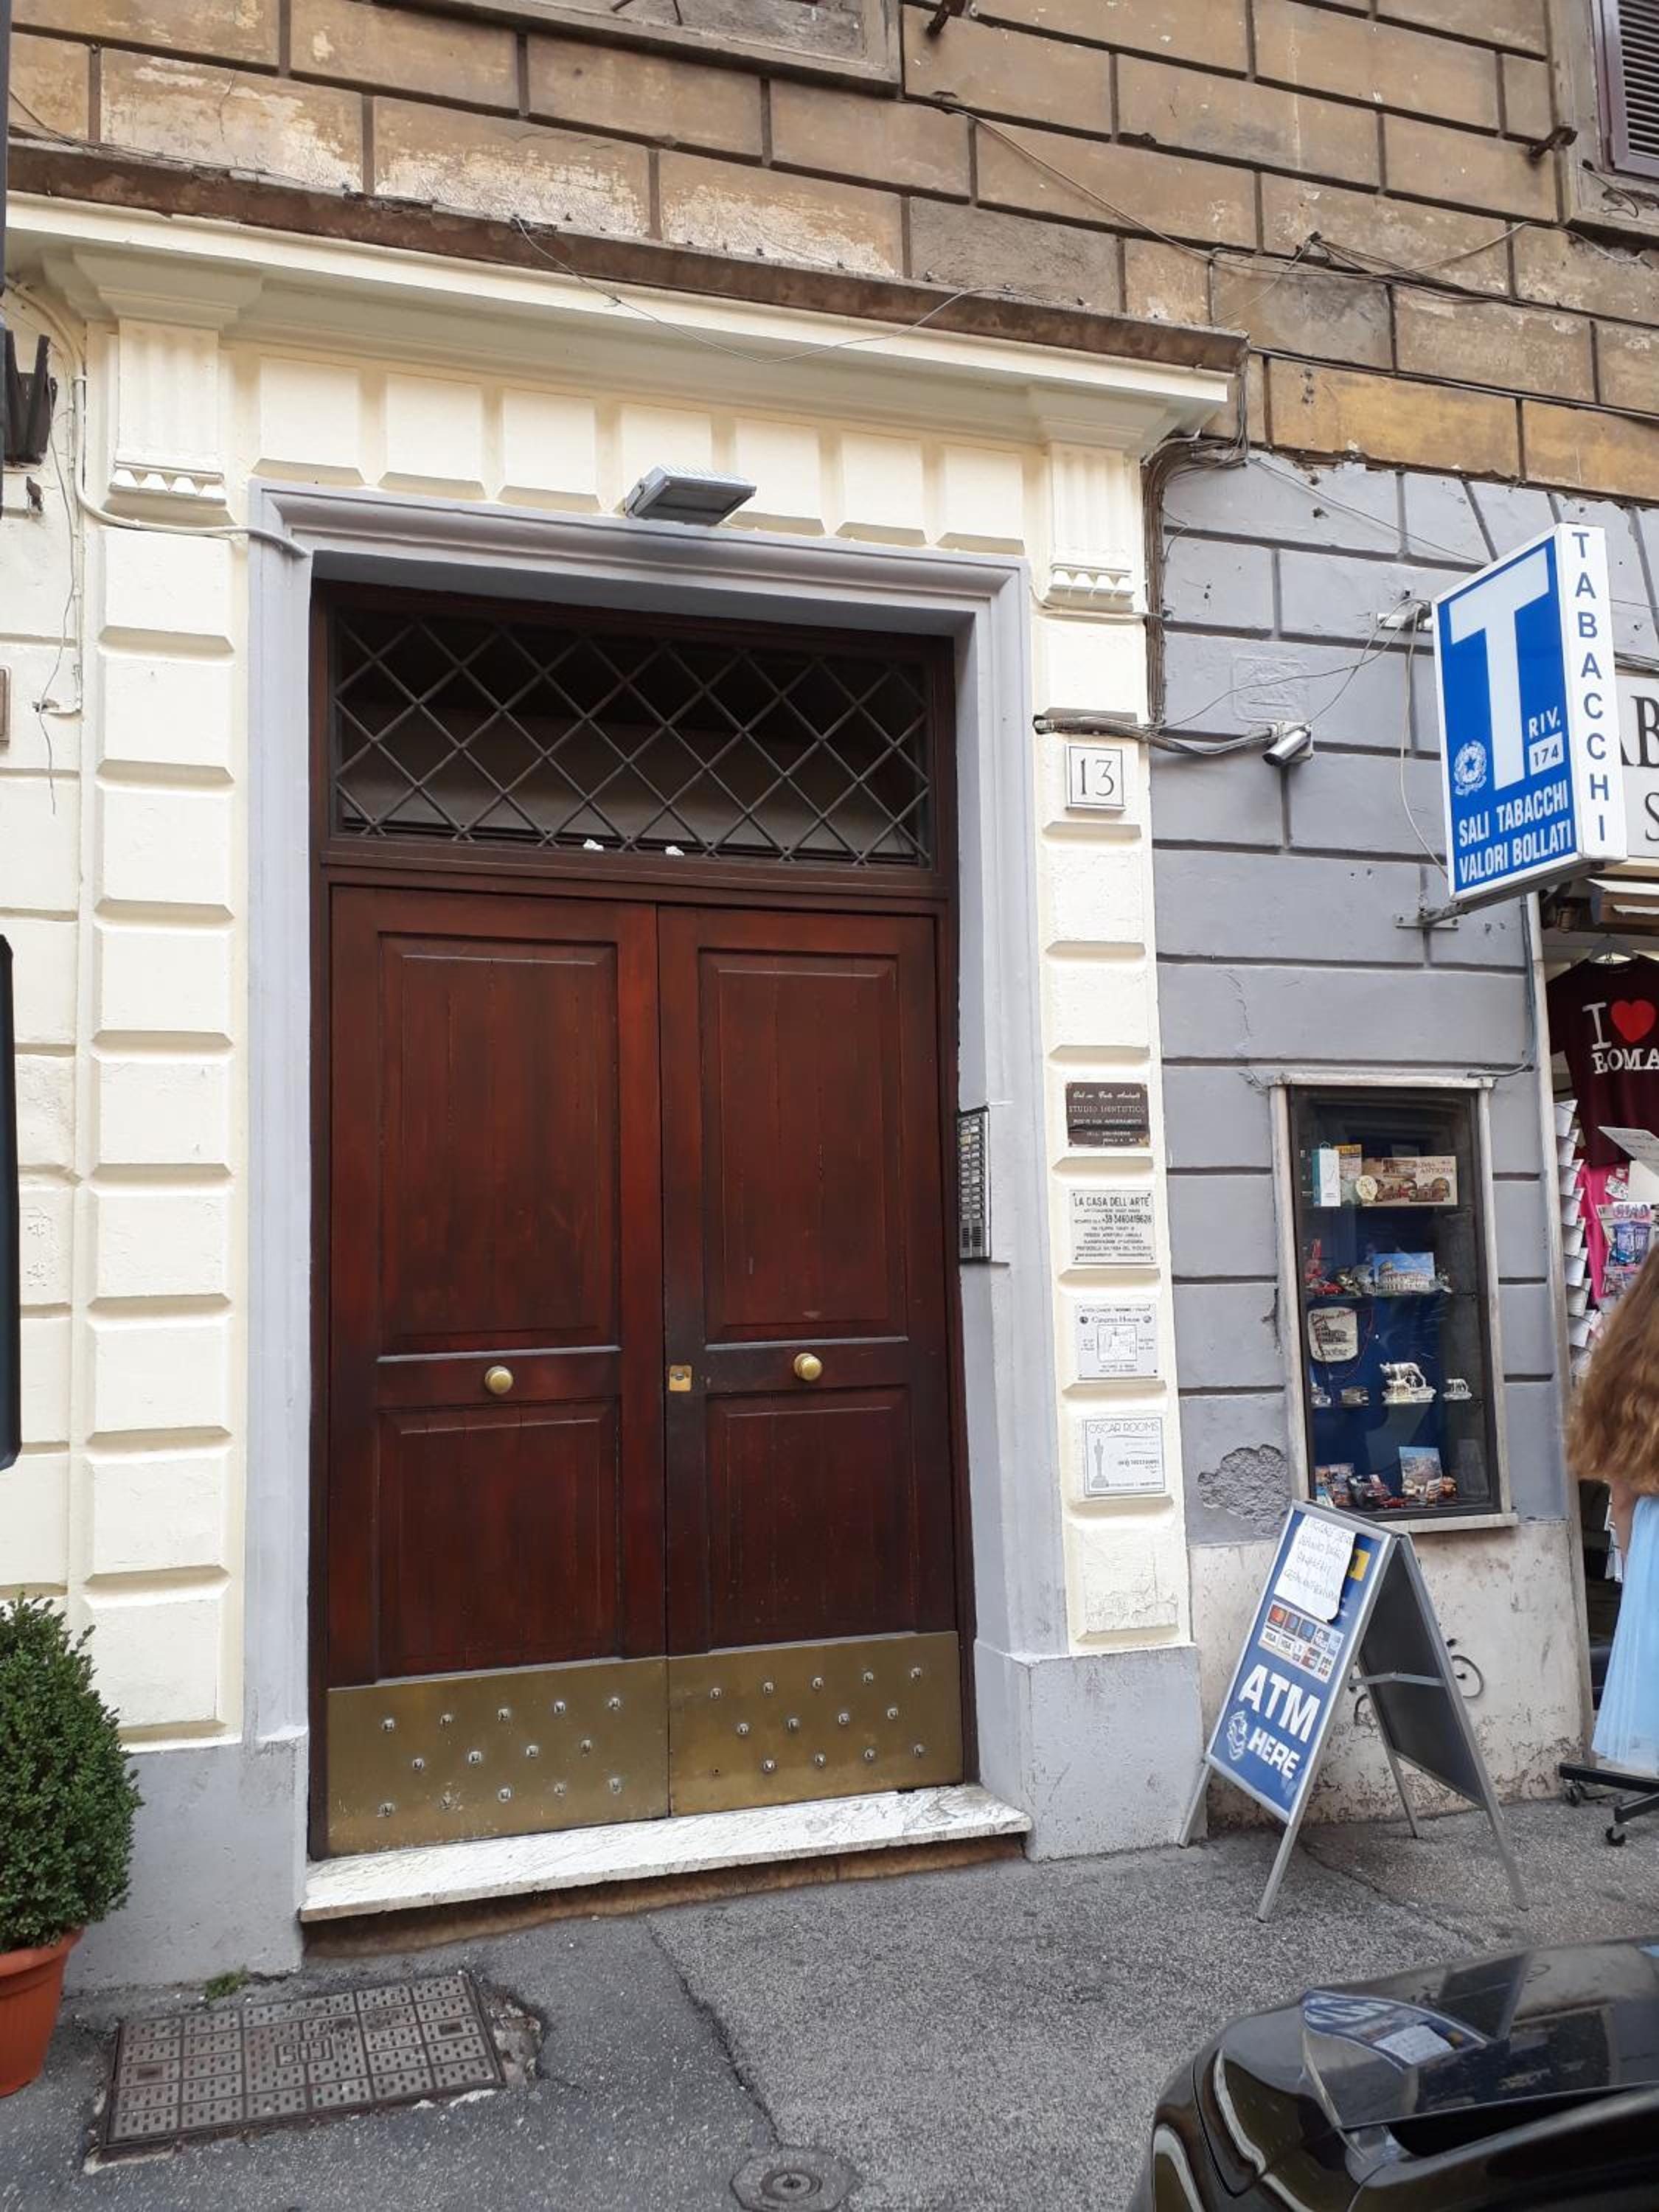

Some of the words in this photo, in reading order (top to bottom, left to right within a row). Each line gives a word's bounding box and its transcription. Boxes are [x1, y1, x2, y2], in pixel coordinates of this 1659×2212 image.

[1450, 546, 1549, 791] T
[1571, 532, 1610, 842] TABACCHI
[1528, 705, 1561, 737] RIV.
[1619, 695, 1659, 769] B
[1080, 757, 1114, 797] 13
[1534, 742, 1560, 769] 174
[1458, 810, 1490, 848] SALI
[1496, 779, 1568, 832] TABACCHI
[1458, 841, 1509, 884] VALORI
[1512, 819, 1573, 866] BOLLATI
[1582, 1001, 1613, 1051] I
[1074, 1196, 1085, 1207] LA
[1086, 1196, 1108, 1207] CASA
[1110, 1196, 1150, 1207] DELL'ARTE
[1239, 1663, 1321, 1744] ATM
[1247, 1726, 1301, 1779] HERE
